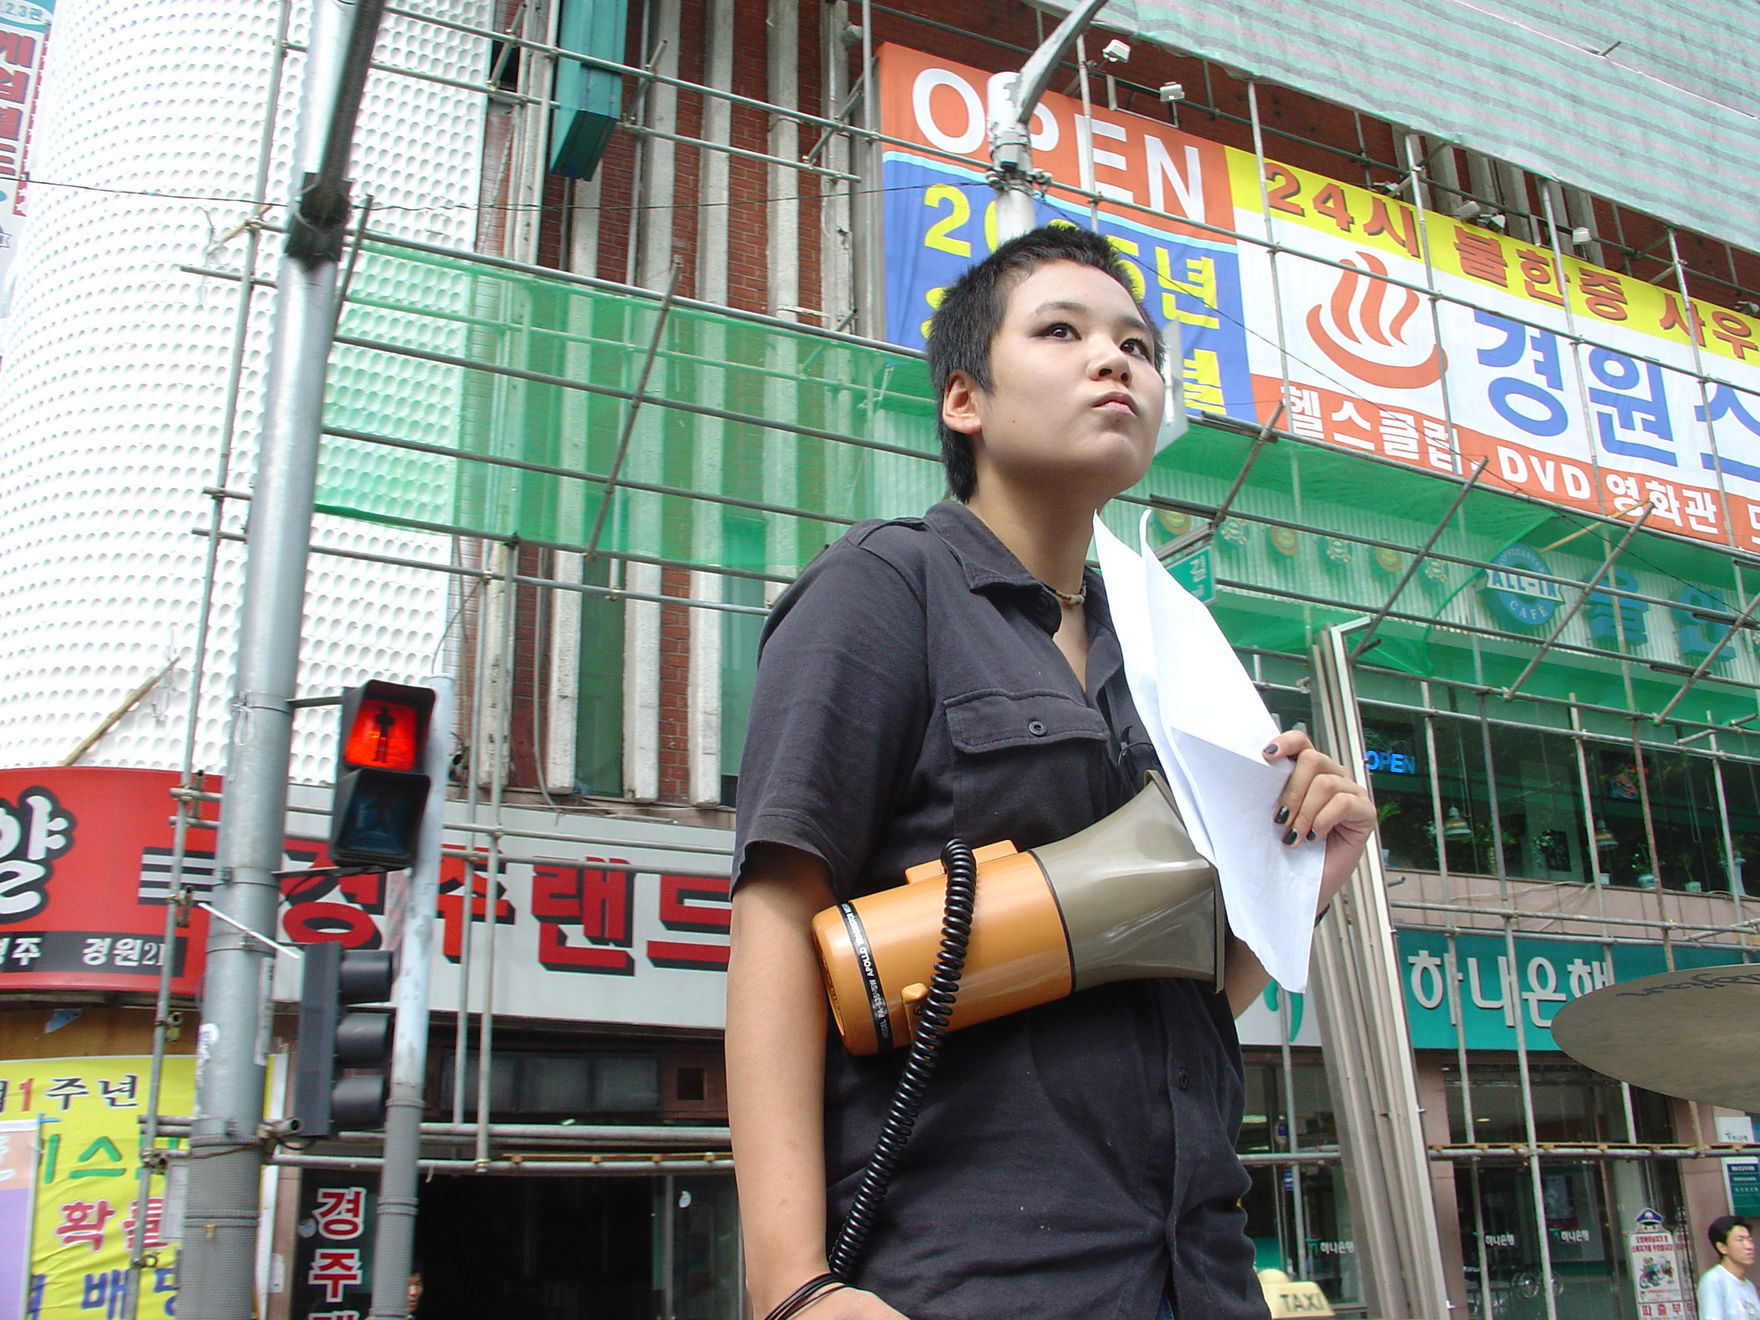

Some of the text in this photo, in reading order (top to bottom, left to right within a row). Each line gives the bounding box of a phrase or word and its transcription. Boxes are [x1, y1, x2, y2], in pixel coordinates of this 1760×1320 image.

[924, 183, 1220, 330] 25년
[1264, 162, 1420, 258] 24시
[1453, 225, 1629, 322] 불한증
[1497, 445, 1592, 501] DVD
[1605, 473, 1719, 535] 영화관
[1365, 750, 1416, 775] OPEN
[858, 946, 875, 977] APOLLO
[0, 1074, 139, 1113] 1주년
[308, 1187, 367, 1320] 경주
[1279, 1292, 1323, 1313] TAXI
